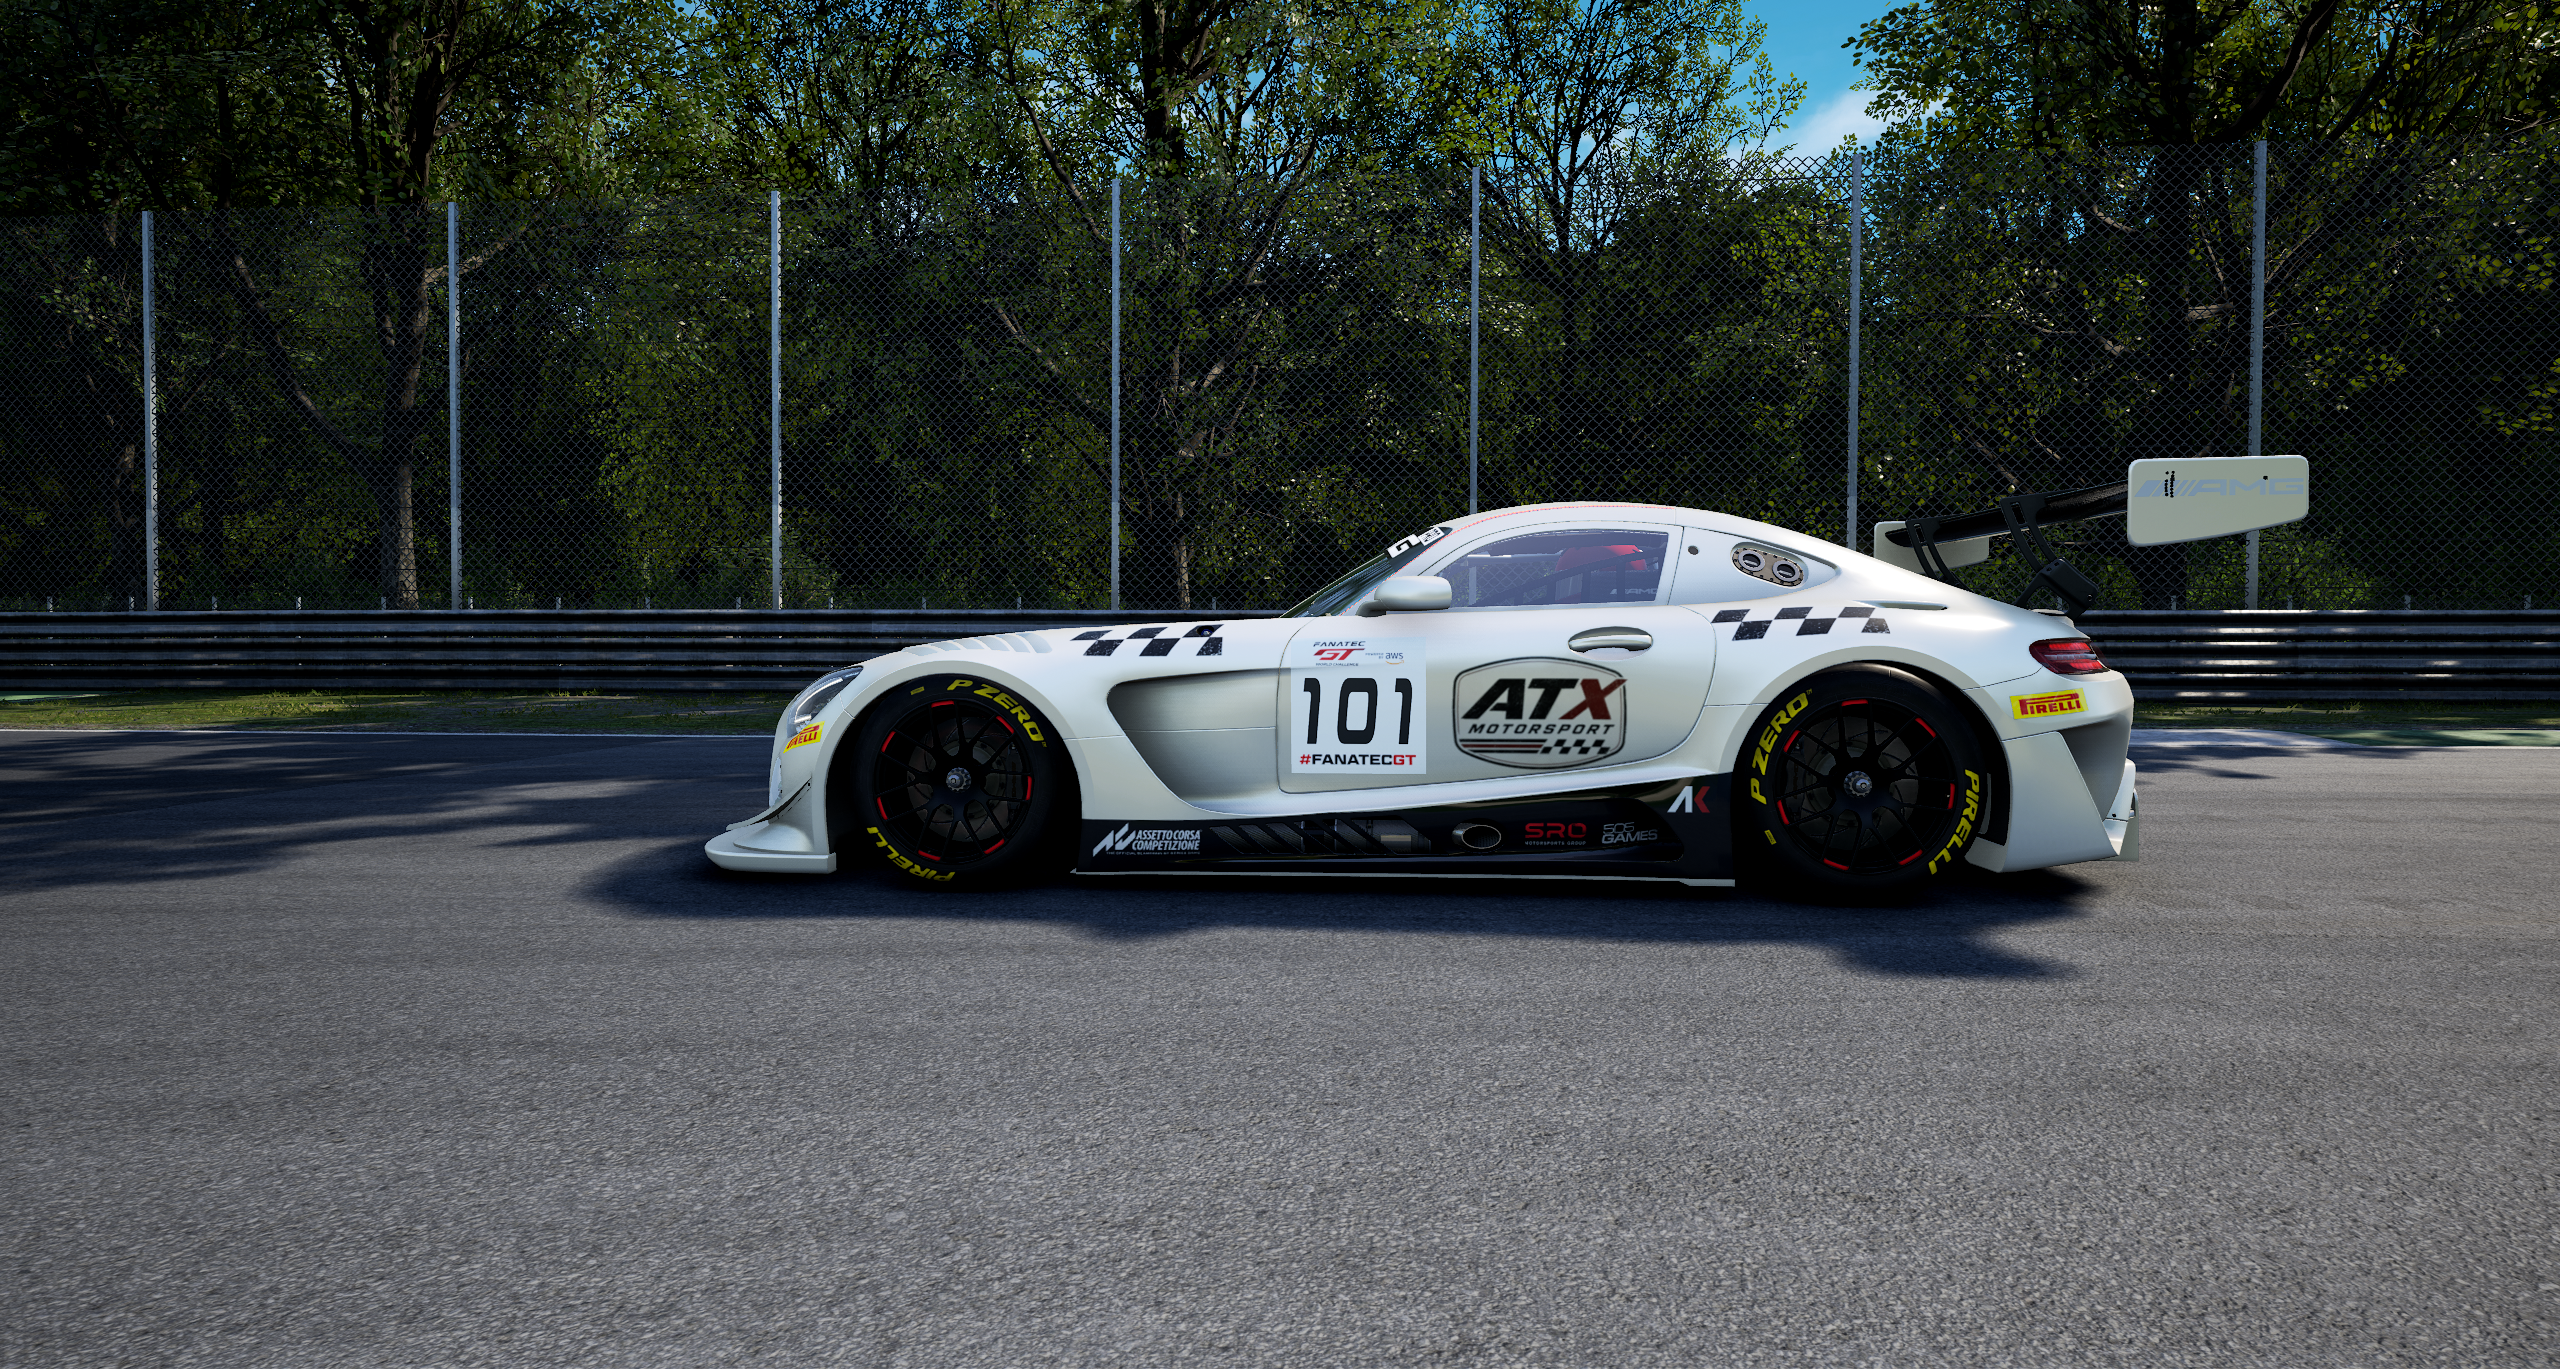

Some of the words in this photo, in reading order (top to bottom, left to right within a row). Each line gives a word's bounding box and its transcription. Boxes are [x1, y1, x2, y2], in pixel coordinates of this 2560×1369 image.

[1313, 648, 1366, 661] GT
[1385, 652, 1404, 660] aws
[1461, 678, 1628, 720] ATX
[2019, 692, 2082, 716] PIRELLI
[947, 679, 974, 691] P
[973, 683, 1045, 742] ZERO
[1303, 678, 1413, 745] 101
[1468, 724, 1616, 735] MOTORSPORT
[1752, 692, 1809, 776] ZERO
[1299, 754, 1417, 766] #FANATECGT
[1750, 777, 1767, 805] P
[1524, 822, 1587, 839] SRO
[1928, 769, 1980, 875] PIRELLI
[1135, 830, 1173, 840] ASSETTO
[1173, 830, 1201, 840] CORSA
[1601, 829, 1659, 844] GAMES
[866, 826, 956, 882] PIRELLI
[1131, 841, 1200, 851] COMPETIZIONE
